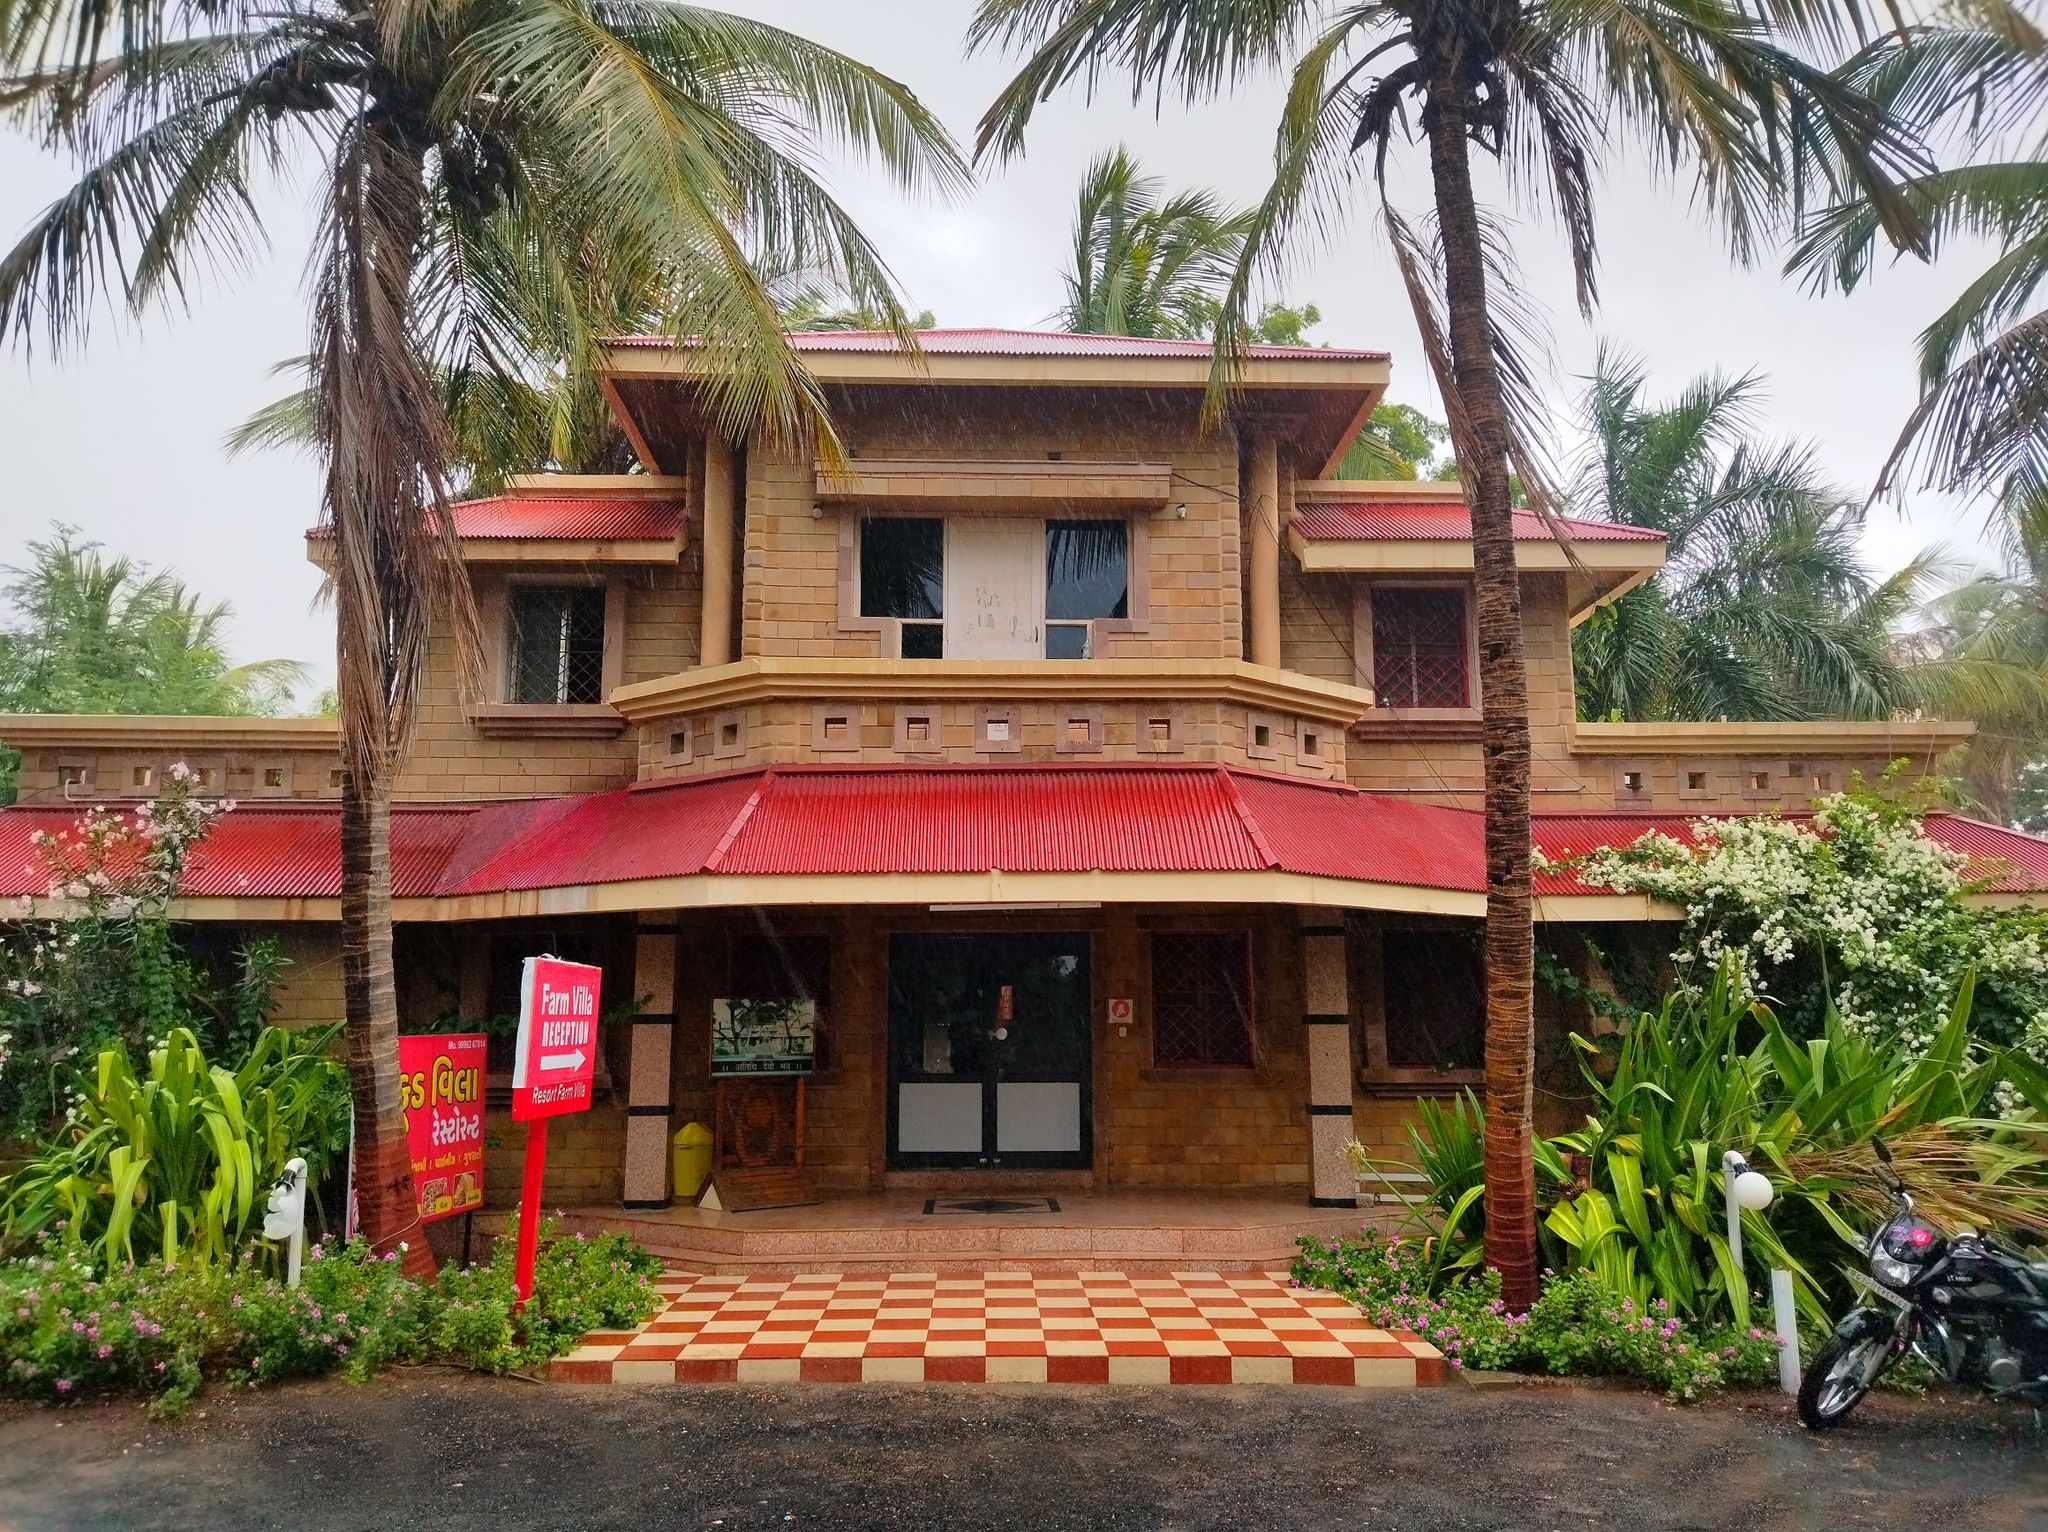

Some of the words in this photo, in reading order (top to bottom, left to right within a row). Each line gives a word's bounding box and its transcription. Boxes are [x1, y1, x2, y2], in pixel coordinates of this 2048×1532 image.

[541, 983, 570, 1016] Farm
[573, 985, 593, 1016] Villa
[542, 1020, 589, 1047] RECEPTION
[735, 1061, 757, 1072] अतिथि
[762, 1060, 775, 1071] देवो
[431, 1054, 478, 1108] વિલા
[532, 1085, 557, 1105] Resort
[556, 1082, 574, 1101] Farm
[574, 1081, 586, 1099] Villa
